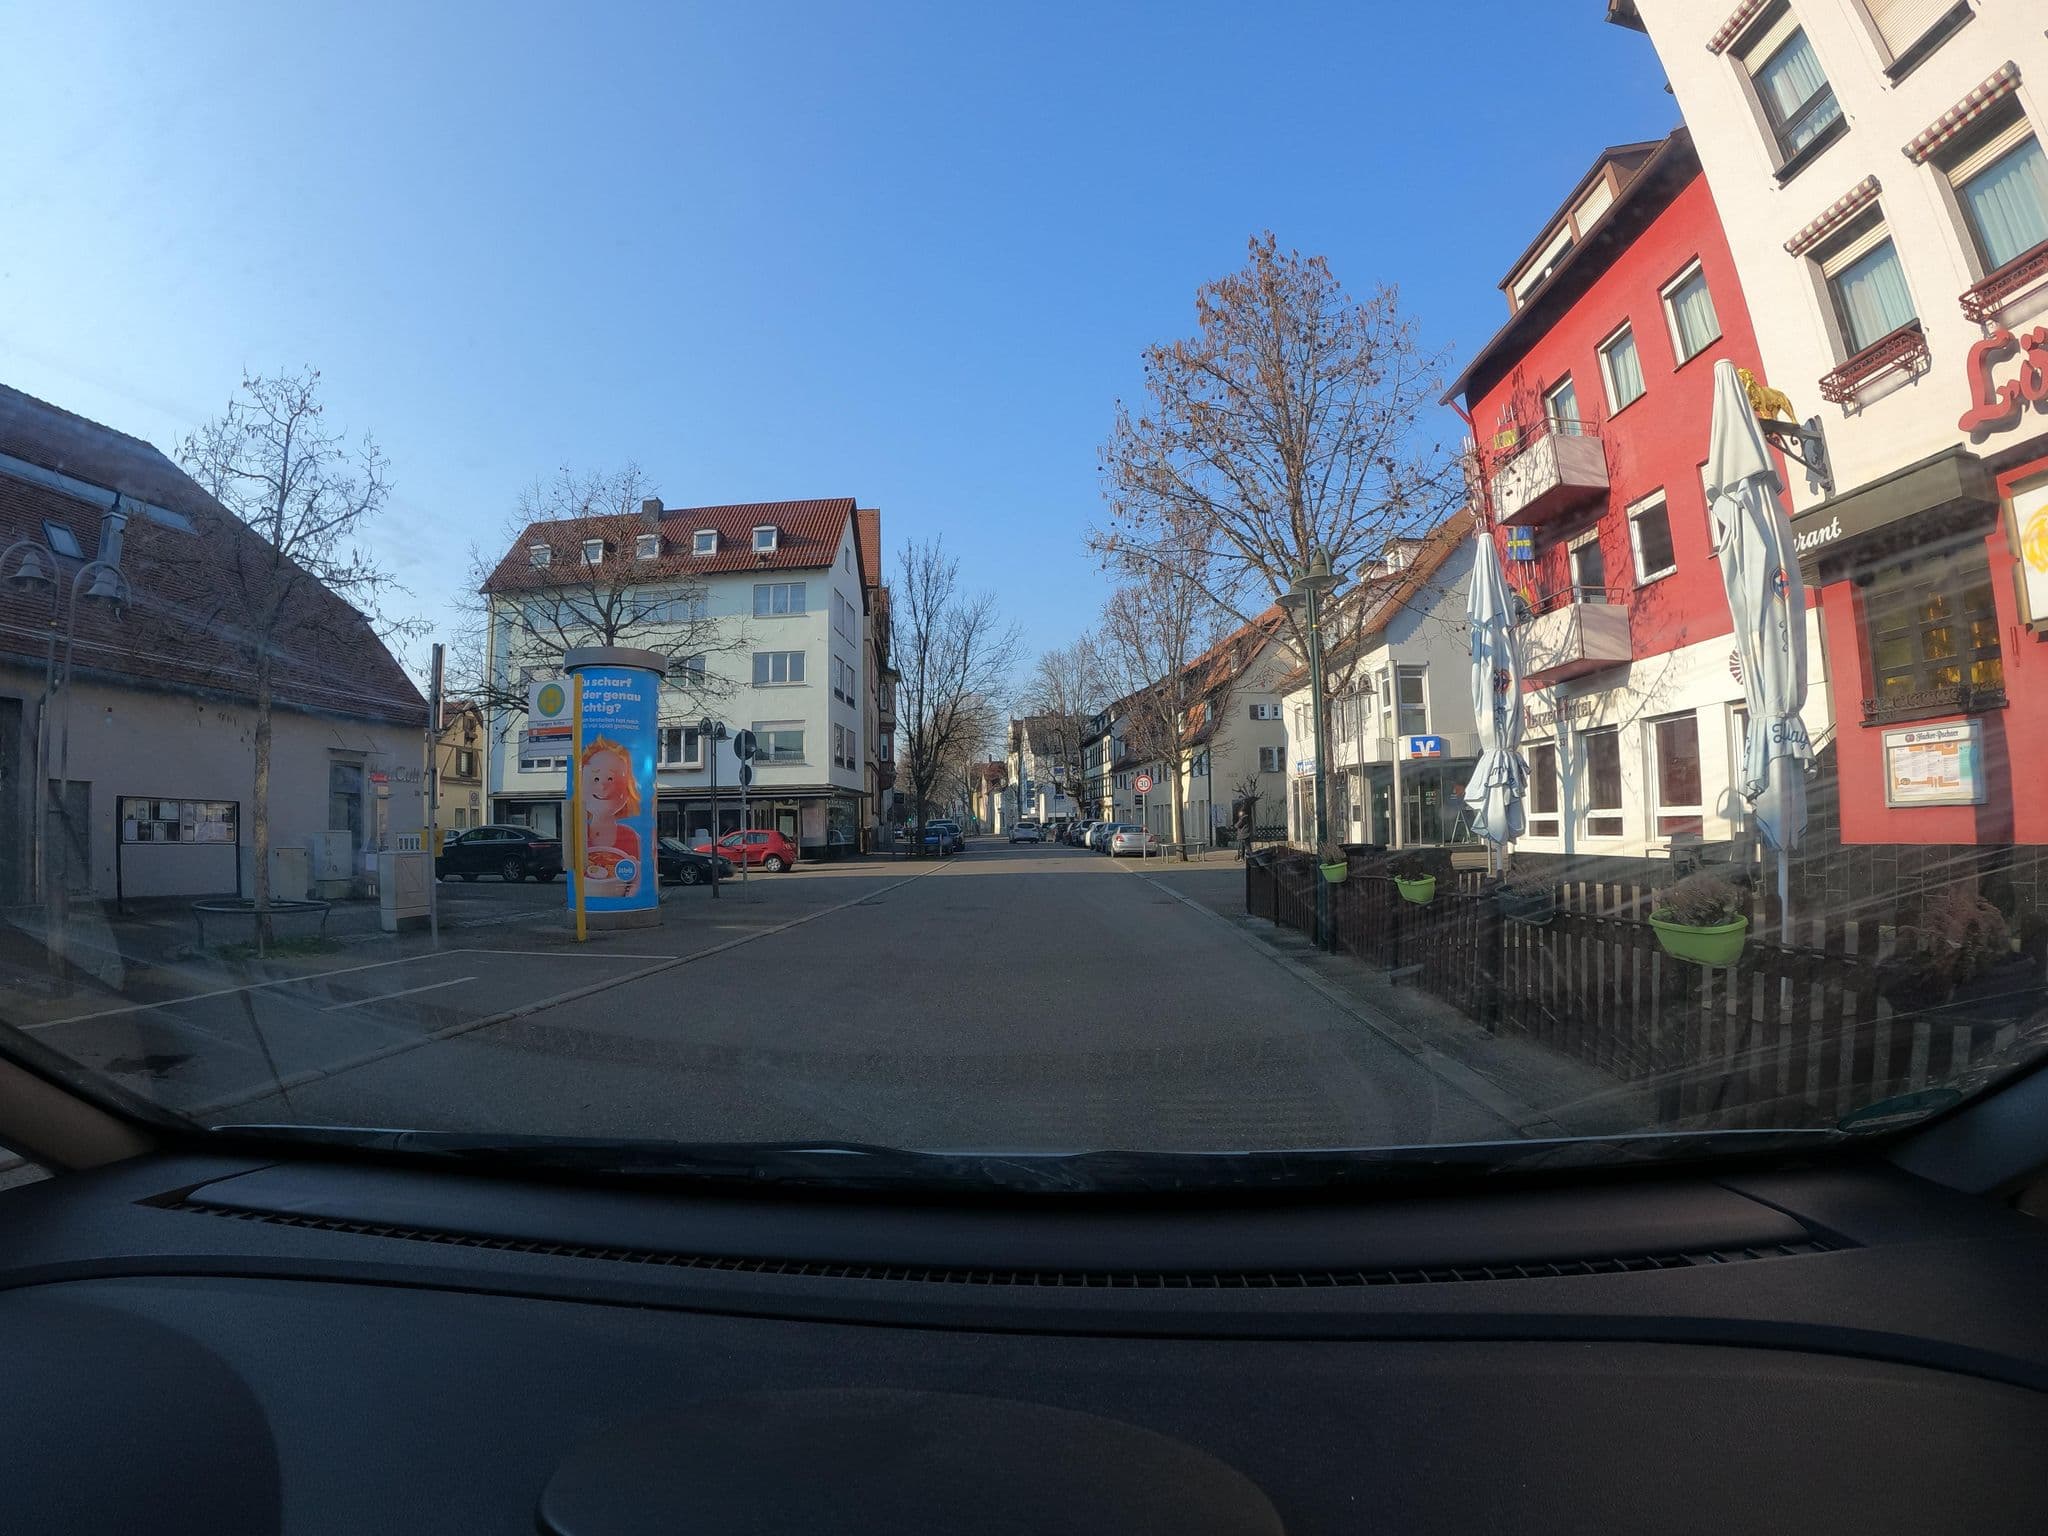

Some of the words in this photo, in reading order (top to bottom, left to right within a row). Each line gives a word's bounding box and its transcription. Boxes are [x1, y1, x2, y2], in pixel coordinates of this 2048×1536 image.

[592, 677, 632, 687] scharf
[582, 690, 602, 699] der
[603, 691, 641, 702] genau
[1139, 780, 1149, 788] 30
